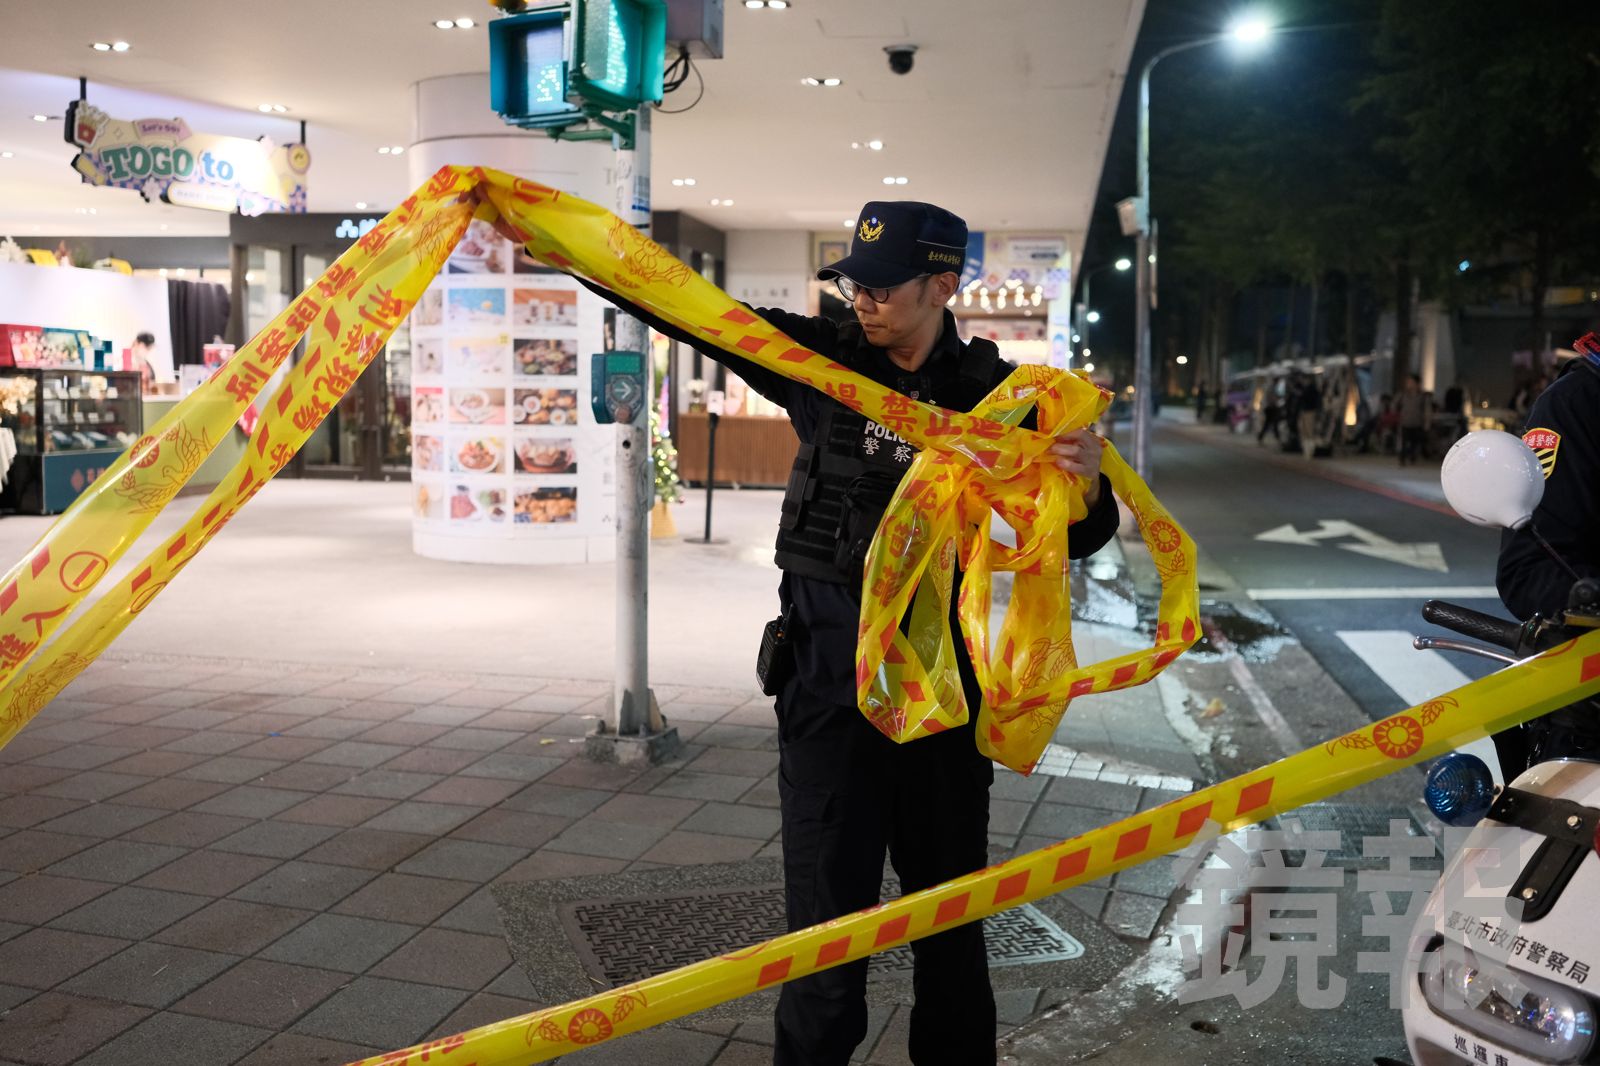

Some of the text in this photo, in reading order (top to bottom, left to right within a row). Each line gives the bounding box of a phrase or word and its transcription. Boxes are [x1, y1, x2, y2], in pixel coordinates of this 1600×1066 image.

[102, 146, 193, 180] TOGO
[862, 437, 912, 463] 警察
[1446, 910, 1590, 984] 臺北市政府警察局
